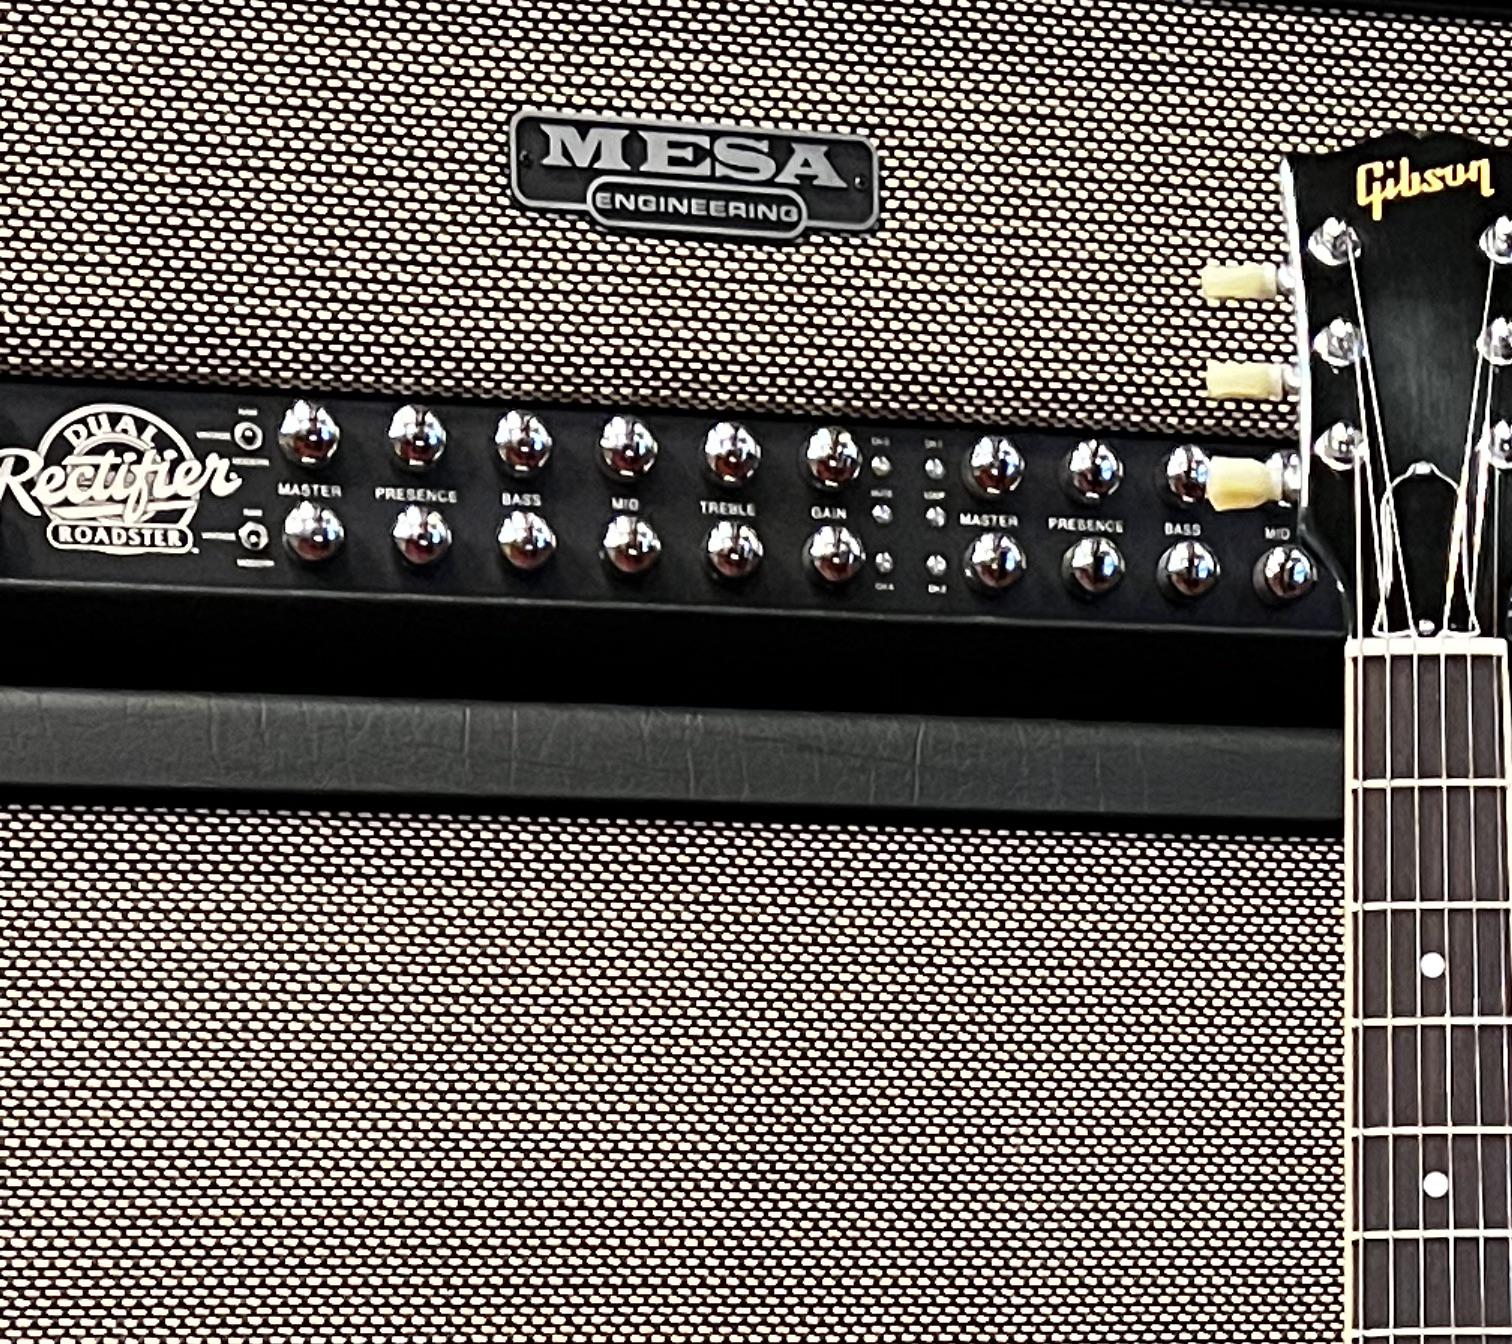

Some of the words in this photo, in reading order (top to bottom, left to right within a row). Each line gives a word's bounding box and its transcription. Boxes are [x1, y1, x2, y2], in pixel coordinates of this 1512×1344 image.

[540, 123, 848, 189] MESA
[1356, 156, 1495, 222] Gibson
[595, 192, 800, 222] ENGINEERING
[62, 412, 158, 450] DUAL
[0, 447, 243, 523] Rectifier
[277, 481, 342, 498] MASTER
[374, 486, 458, 503] PRESENCE
[502, 492, 542, 507] BASS
[700, 500, 756, 517] TREBLE
[811, 505, 848, 520] GAIN
[959, 512, 1019, 528] MASTER
[1048, 516, 1124, 534] PRESENCE
[58, 525, 183, 548] ROADSTER
[1163, 521, 1202, 537] BASS
